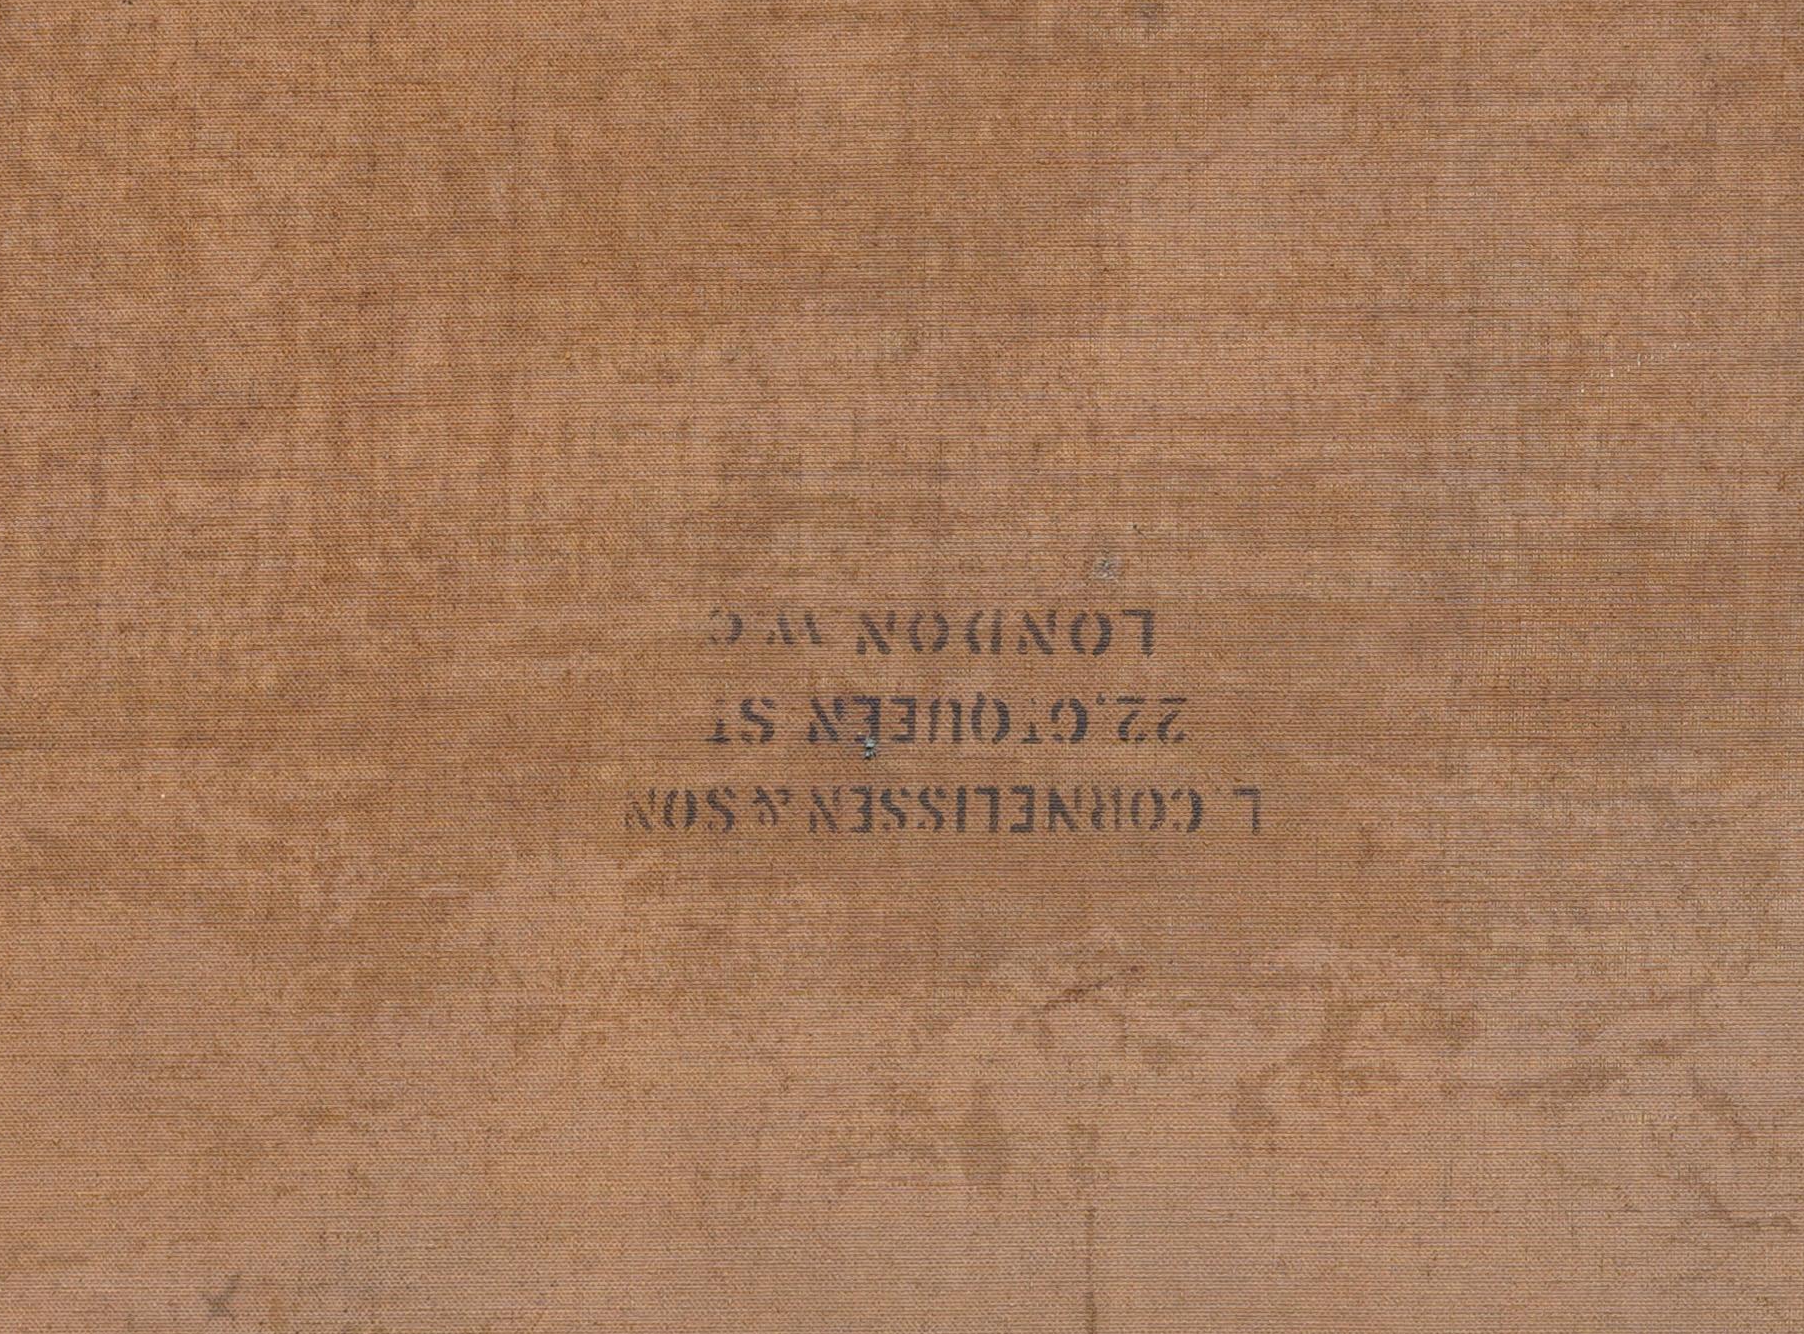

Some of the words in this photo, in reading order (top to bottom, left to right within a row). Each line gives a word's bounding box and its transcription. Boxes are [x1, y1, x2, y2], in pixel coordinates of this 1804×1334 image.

[856, 608, 1155, 657] LONDON
[624, 786, 737, 834] SON
[752, 787, 792, 826] &
